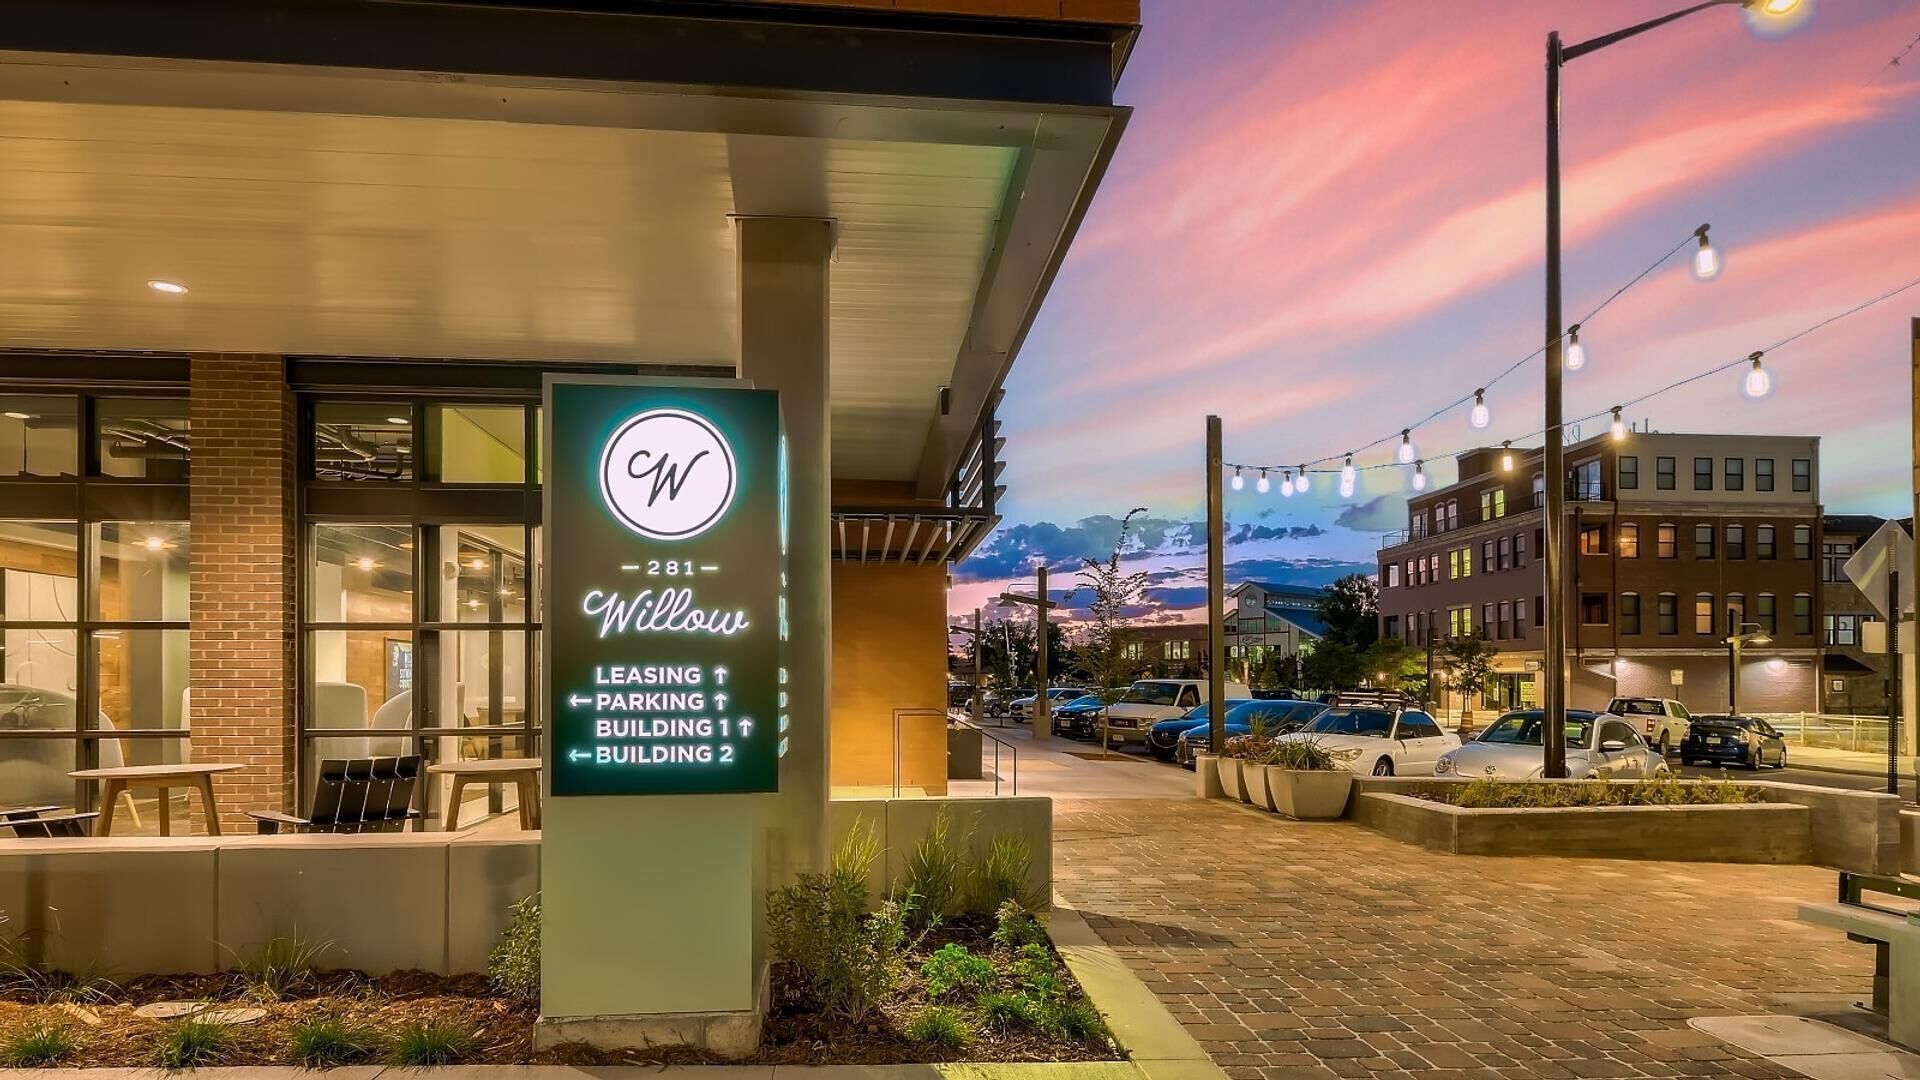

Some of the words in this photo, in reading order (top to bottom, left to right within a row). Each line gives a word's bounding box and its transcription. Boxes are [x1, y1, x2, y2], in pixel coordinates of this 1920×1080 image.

[647, 560, 694, 576] 281
[583, 587, 750, 639] Willow
[596, 666, 702, 685] LEASING
[596, 692, 705, 711] PARKING
[596, 718, 713, 738] BUILDING
[719, 718, 729, 737] 1
[596, 744, 712, 764] BUILDING
[719, 744, 734, 763] 2
